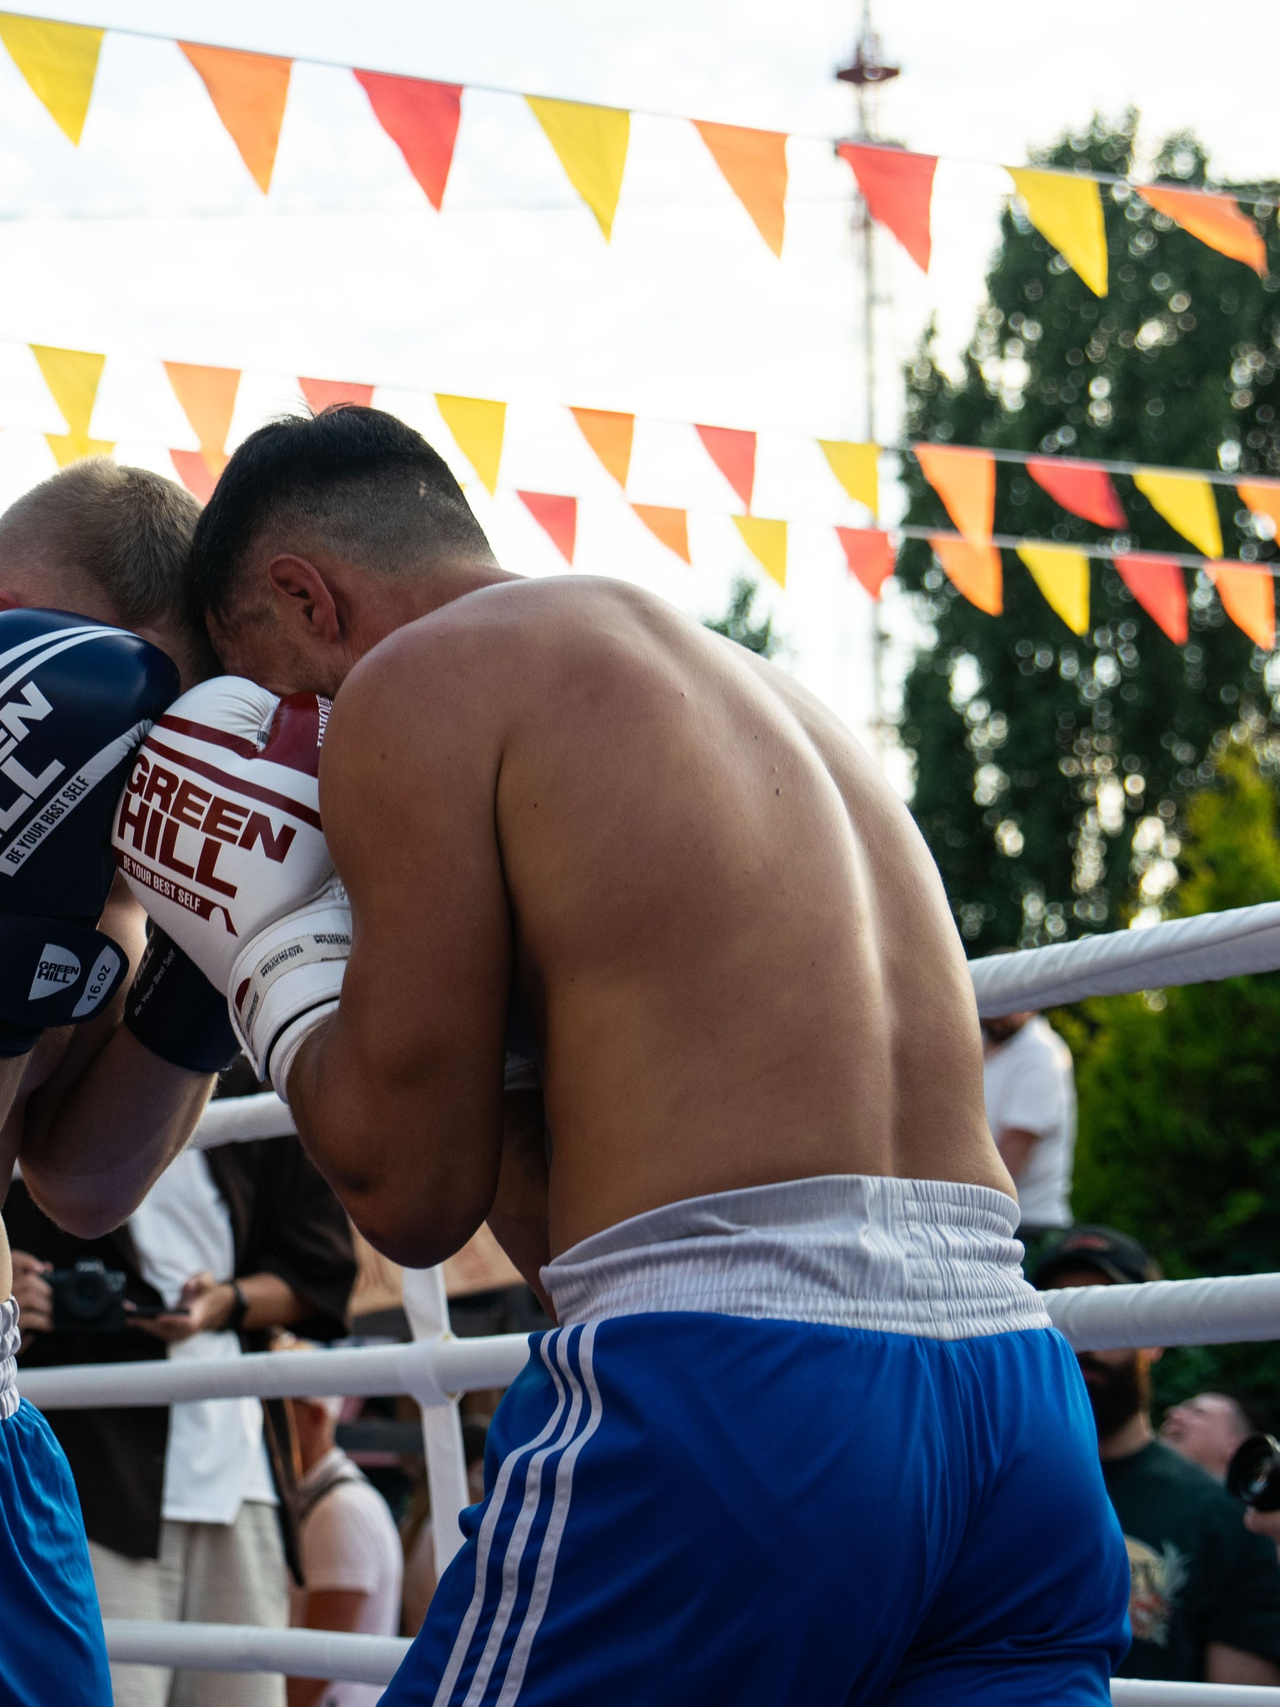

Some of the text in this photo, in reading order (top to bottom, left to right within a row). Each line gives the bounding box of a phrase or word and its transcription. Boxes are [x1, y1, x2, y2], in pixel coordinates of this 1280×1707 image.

[5, 775, 90, 865] BE YOUR BEST SELF
[126, 753, 297, 864] GREEN
[117, 792, 238, 899] HILL
[123, 855, 201, 912] BE YOUR BEST SELF
[36, 969, 70, 984] HILL
[39, 961, 79, 975] GREEN
